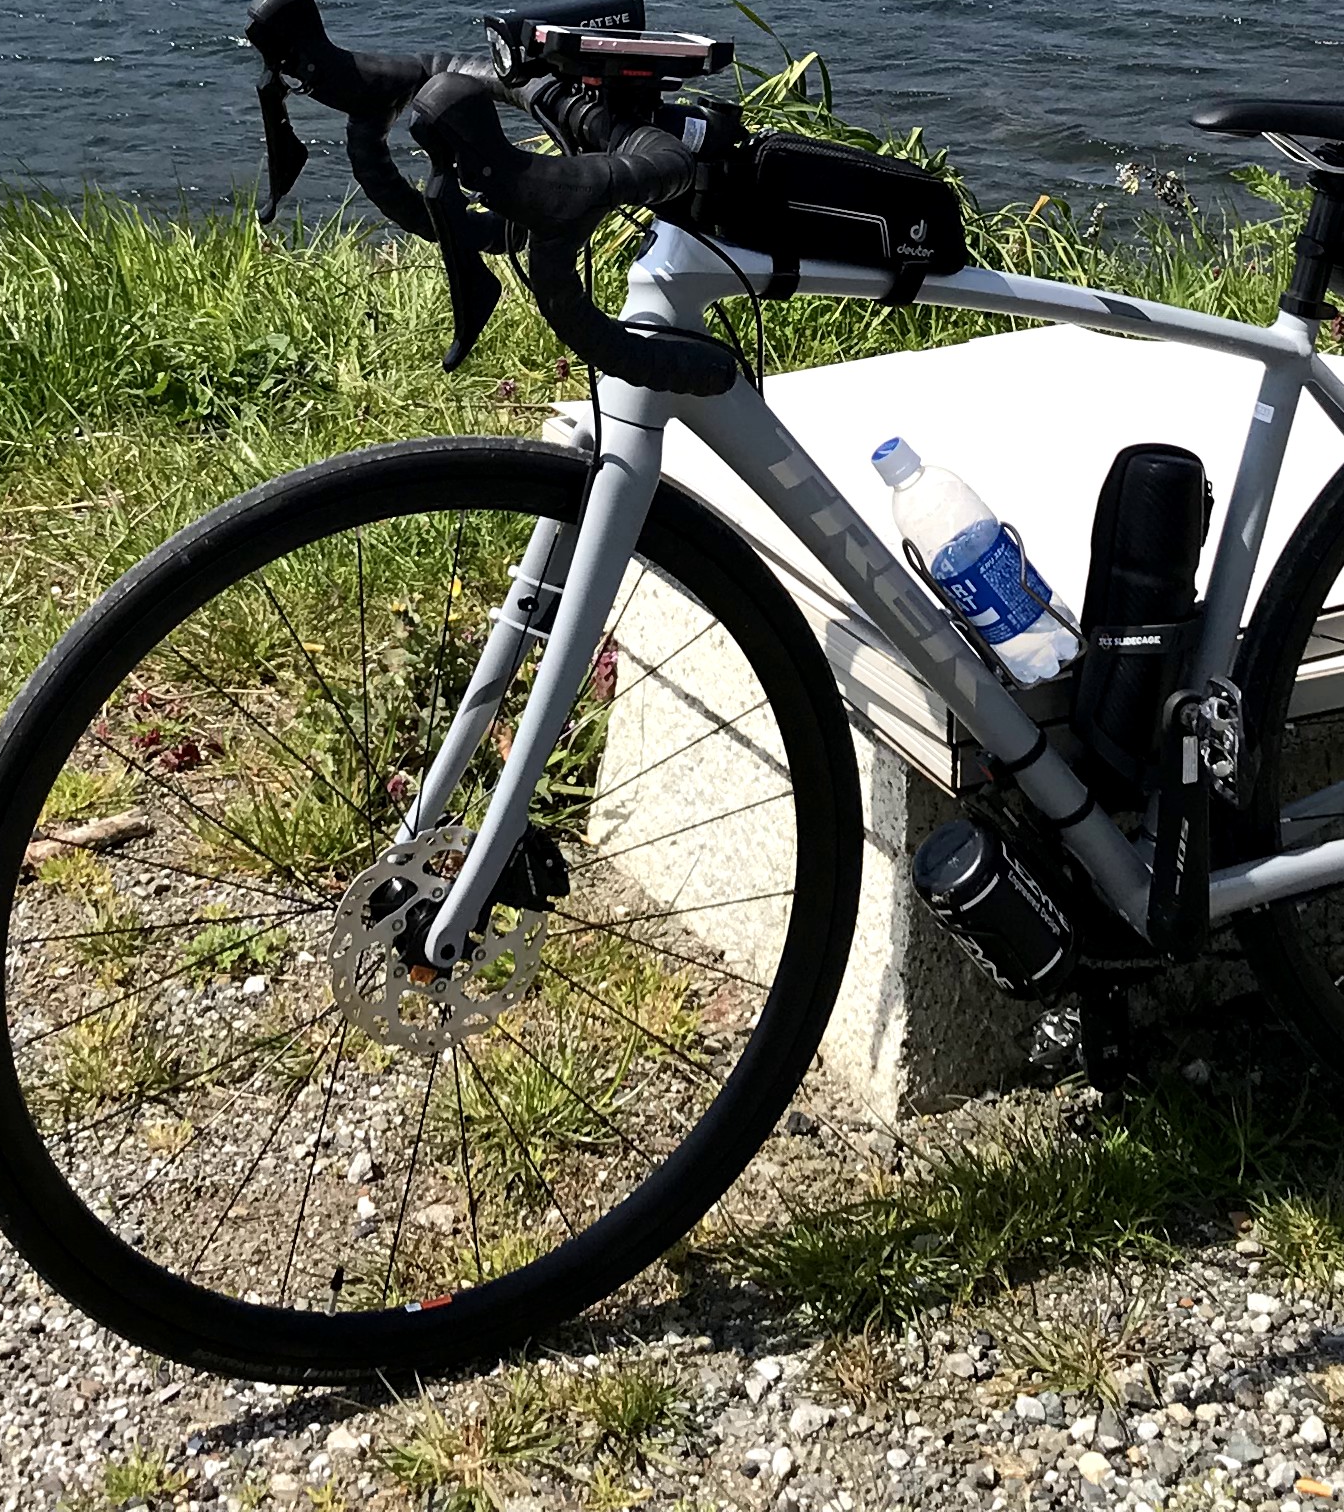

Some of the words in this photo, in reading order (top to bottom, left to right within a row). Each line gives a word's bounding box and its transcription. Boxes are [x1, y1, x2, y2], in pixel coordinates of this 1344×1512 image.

[580, 13, 630, 29] CATEYE
[897, 243, 934, 257] deuter
[767, 427, 992, 707] TREK
[1114, 635, 1161, 646] SLIDECAGE
[1001, 841, 1070, 933] LEZYNE
